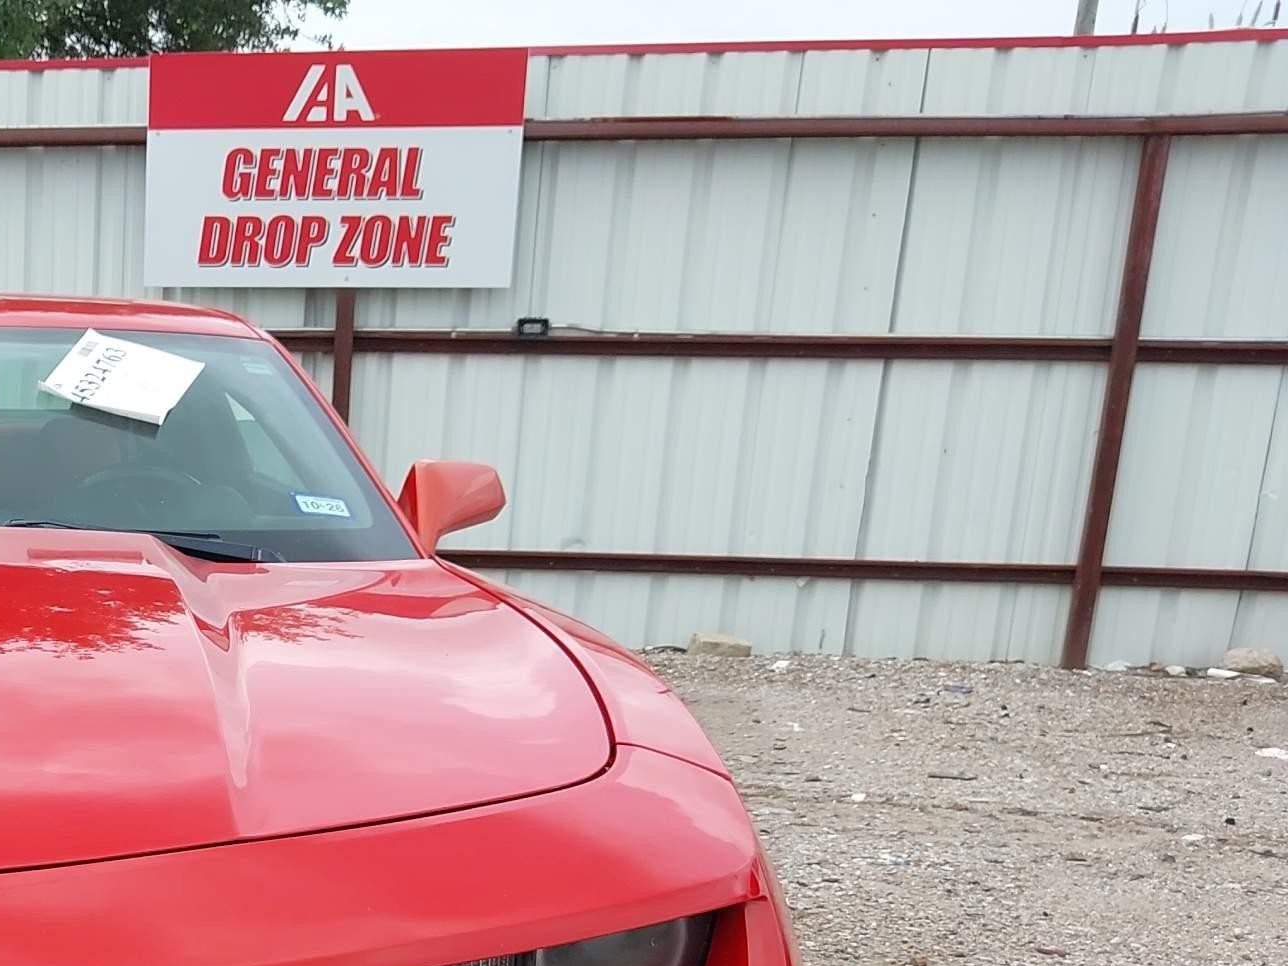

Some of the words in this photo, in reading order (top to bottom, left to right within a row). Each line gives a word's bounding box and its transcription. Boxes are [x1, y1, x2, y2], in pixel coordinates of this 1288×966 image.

[221, 146, 424, 201] GENERAL
[197, 214, 330, 268] DROP
[332, 214, 456, 268] ZONE
[72, 347, 127, 402] 45324763
